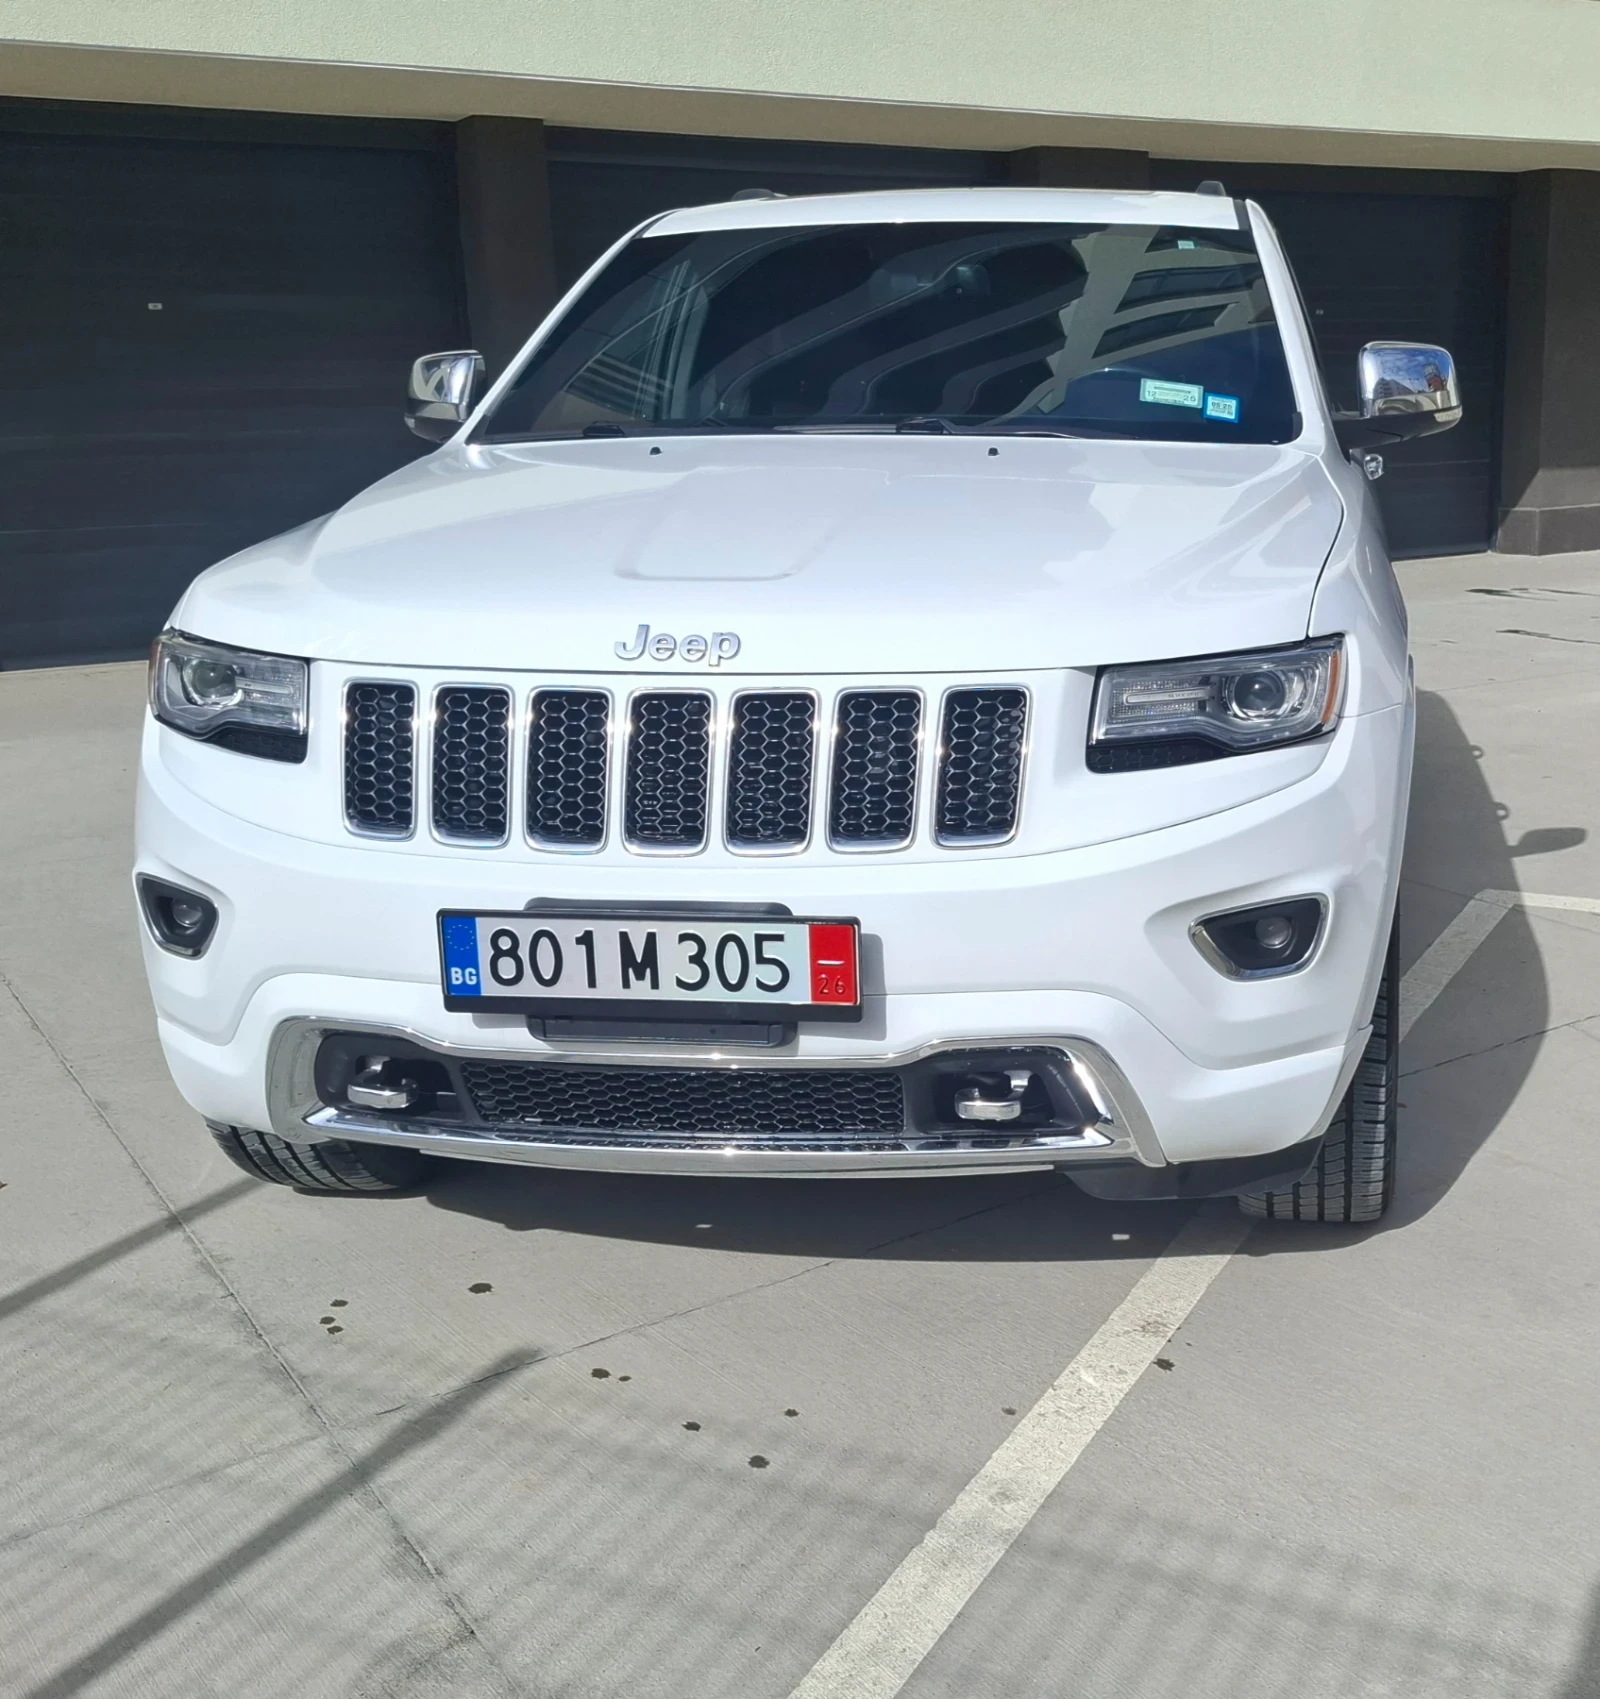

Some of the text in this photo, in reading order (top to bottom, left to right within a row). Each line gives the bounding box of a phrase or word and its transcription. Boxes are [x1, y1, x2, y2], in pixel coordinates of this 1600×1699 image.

[614, 624, 741, 667] Jeep
[451, 967, 477, 986] BG
[489, 927, 791, 994] 801 M 305
[817, 974, 846, 996] 26
